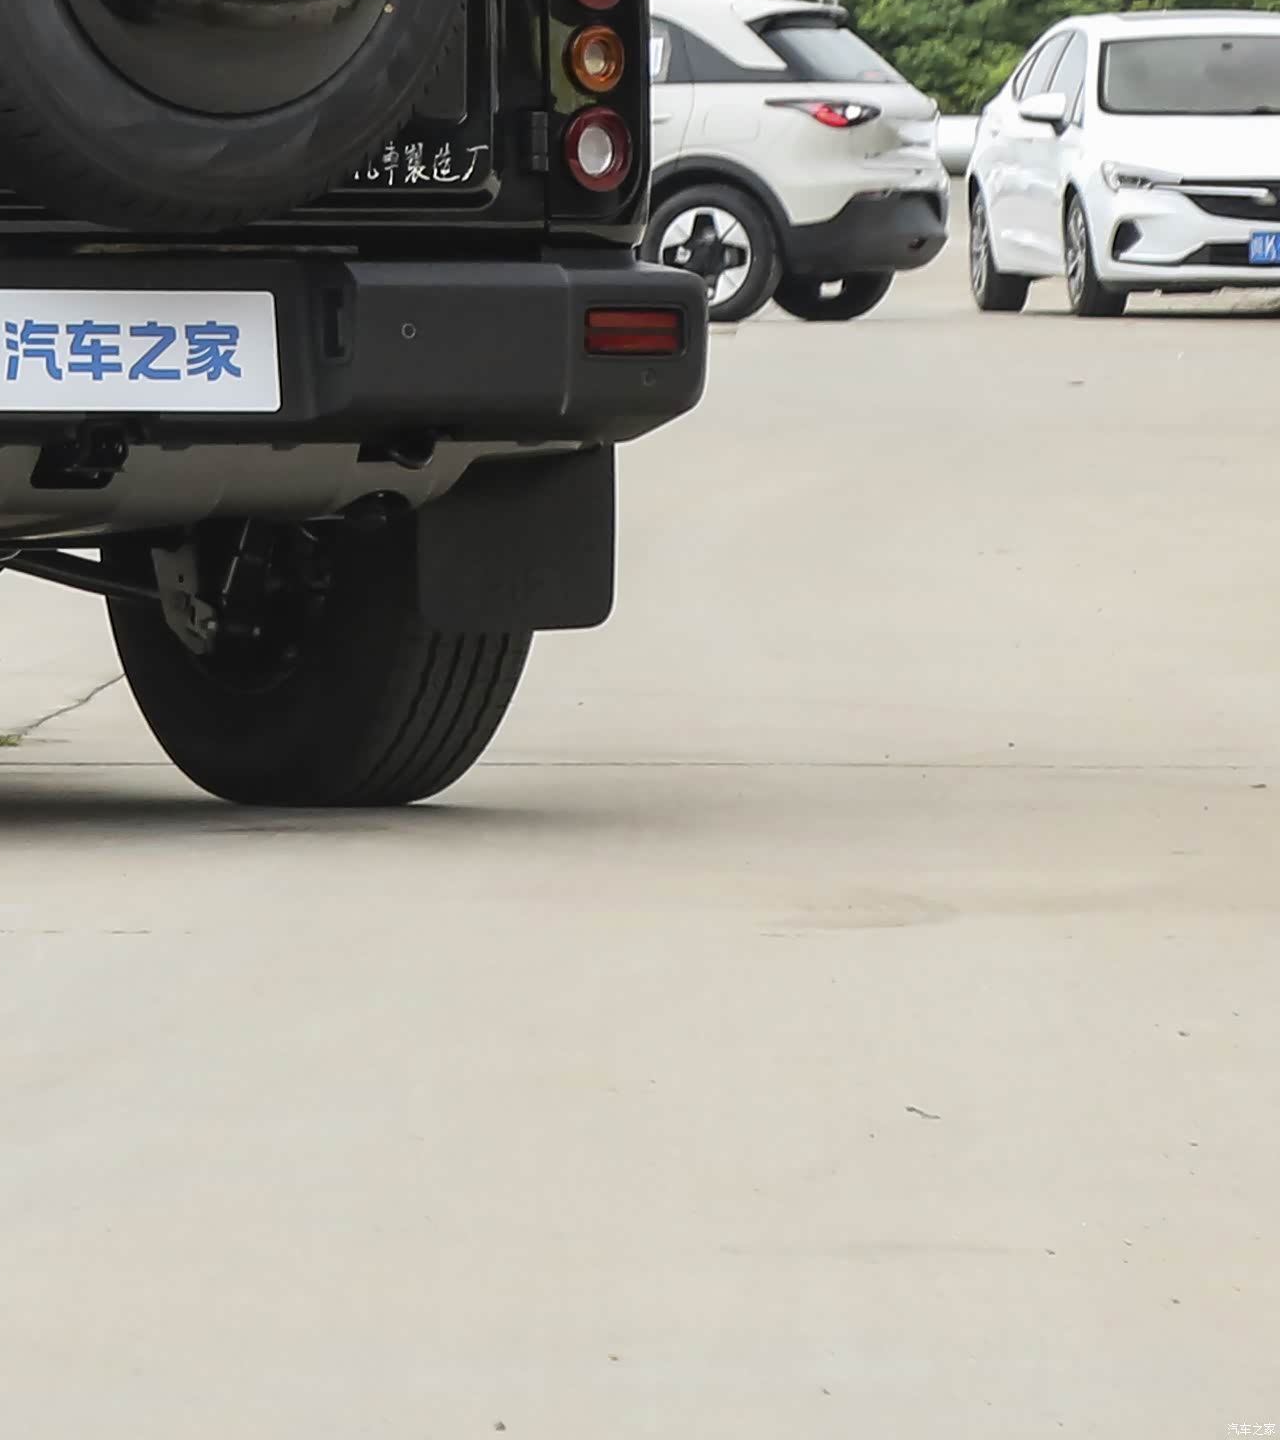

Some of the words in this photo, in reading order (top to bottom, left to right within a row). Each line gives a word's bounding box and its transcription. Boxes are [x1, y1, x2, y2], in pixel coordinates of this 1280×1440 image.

[353, 139, 490, 187] 車製造厂
[4, 318, 243, 383] 汽车之家
